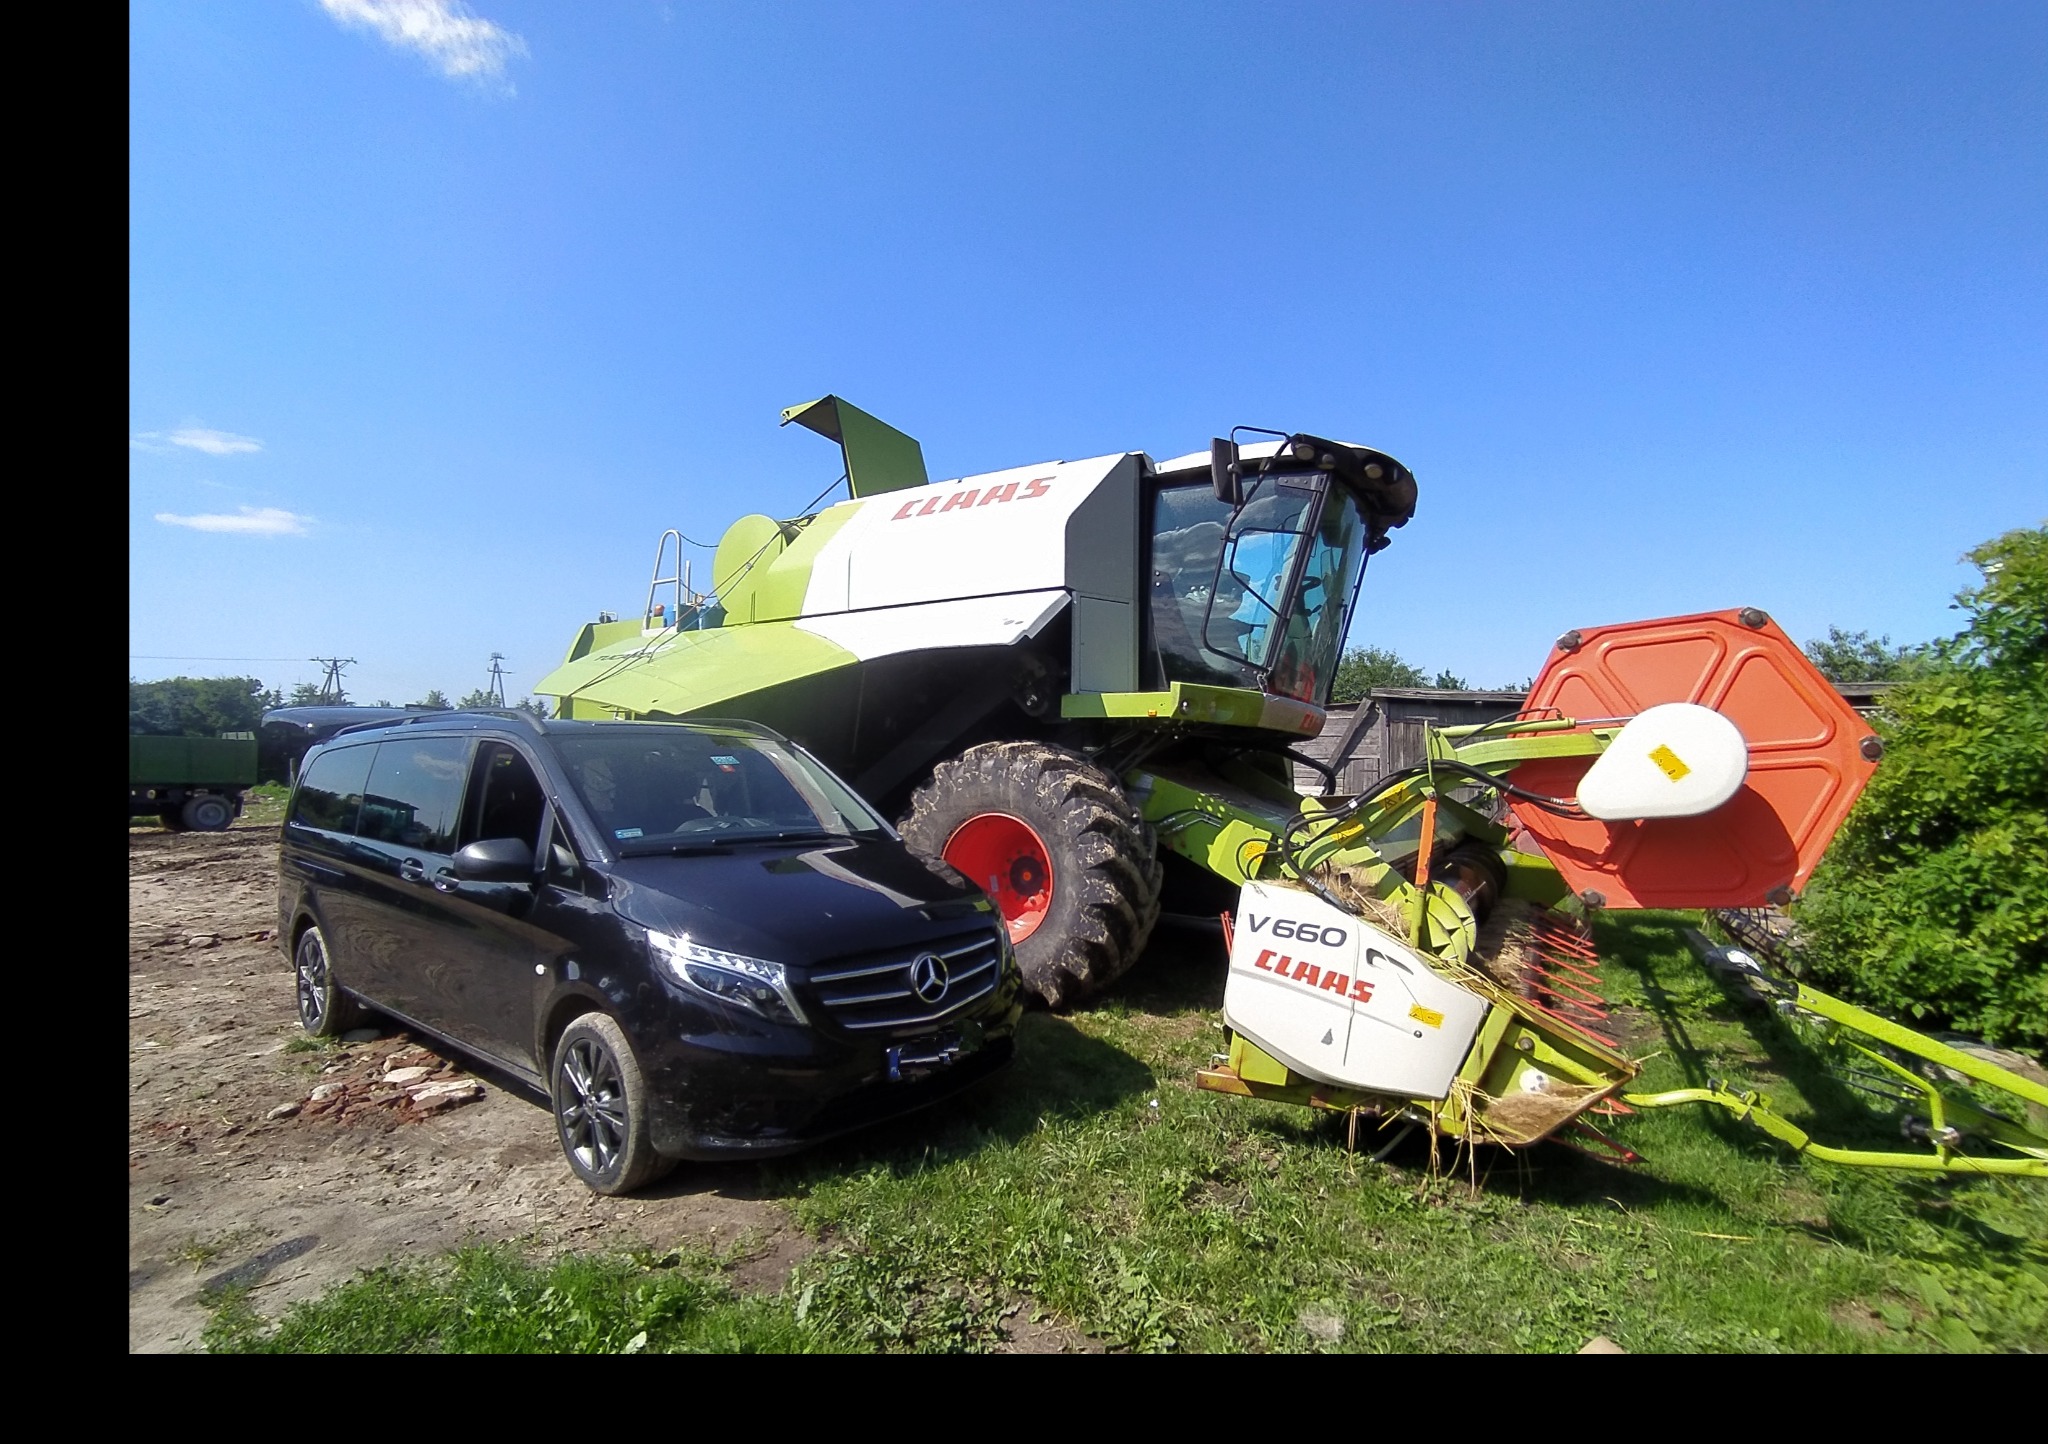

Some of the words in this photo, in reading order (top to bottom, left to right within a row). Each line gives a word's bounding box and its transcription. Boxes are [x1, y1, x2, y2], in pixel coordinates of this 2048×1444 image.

[891, 475, 1057, 521] CLAAS
[1248, 913, 1271, 933] V
[1271, 919, 1348, 948] 660
[1254, 948, 1376, 1004] CLAAS
